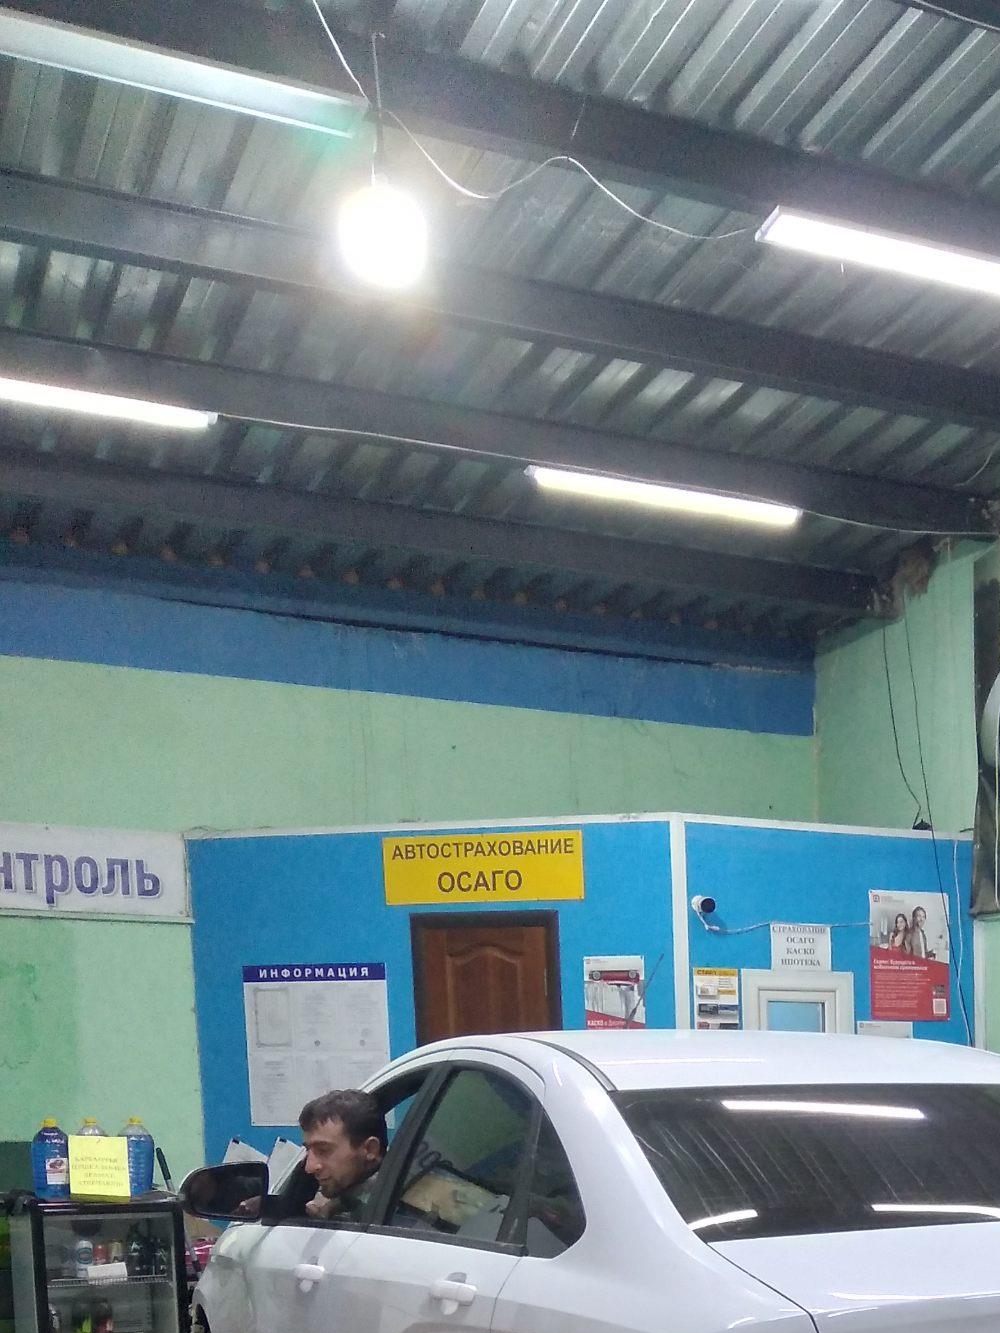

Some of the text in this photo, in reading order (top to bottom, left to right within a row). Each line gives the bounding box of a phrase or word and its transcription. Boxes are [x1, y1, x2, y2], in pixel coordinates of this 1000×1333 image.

[392, 838, 574, 860] АВТОСТРАХОВАНИЕ
[437, 870, 523, 893] ОСАГО
[786, 936, 815, 944] ОСАГО
[786, 947, 815, 956] КАСКО
[781, 958, 821, 967] ИПОТЕКА
[259, 966, 369, 980] ИНФОРМАЦИЯ
